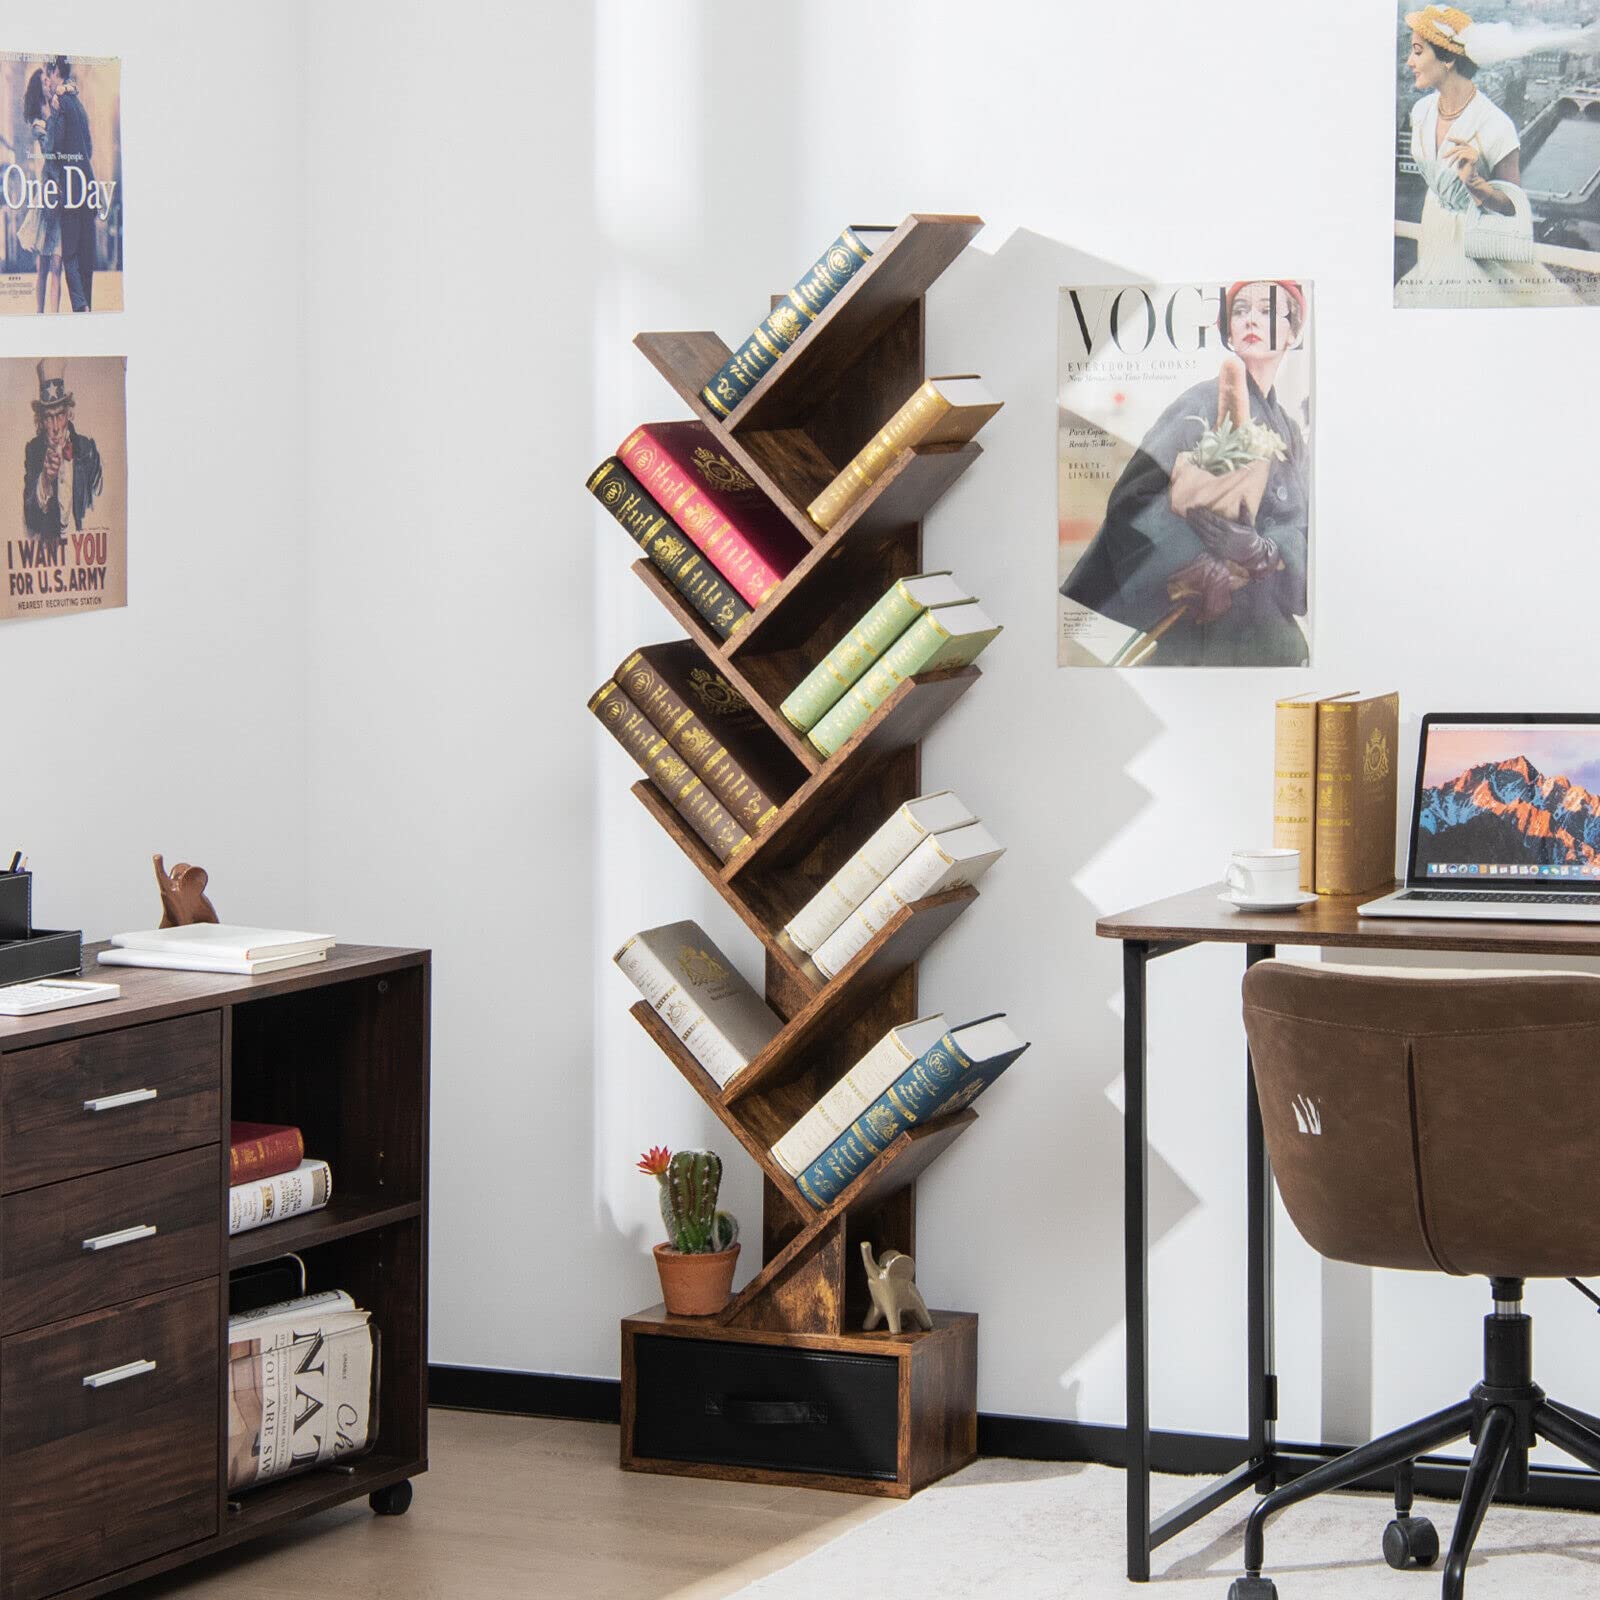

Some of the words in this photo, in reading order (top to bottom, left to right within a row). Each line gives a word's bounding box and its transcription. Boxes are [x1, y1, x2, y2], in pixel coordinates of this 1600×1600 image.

[3, 164, 59, 210] One
[63, 166, 117, 221] Day
[1068, 361, 1141, 372] EVERYBODY
[1069, 428, 1085, 436] Paris
[7, 541, 13, 569] I
[18, 538, 68, 569] WANT
[71, 532, 107, 567] YOU
[10, 573, 34, 595] FOR
[69, 567, 107, 592] ARMY
[18, 600, 44, 610] NEAREST
[46, 599, 79, 608] RECRUITING
[80, 597, 102, 606] STATION
[262, 1346, 276, 1388] YOU
[264, 1398, 276, 1437] ARE
[280, 1406, 288, 1424] WITH
